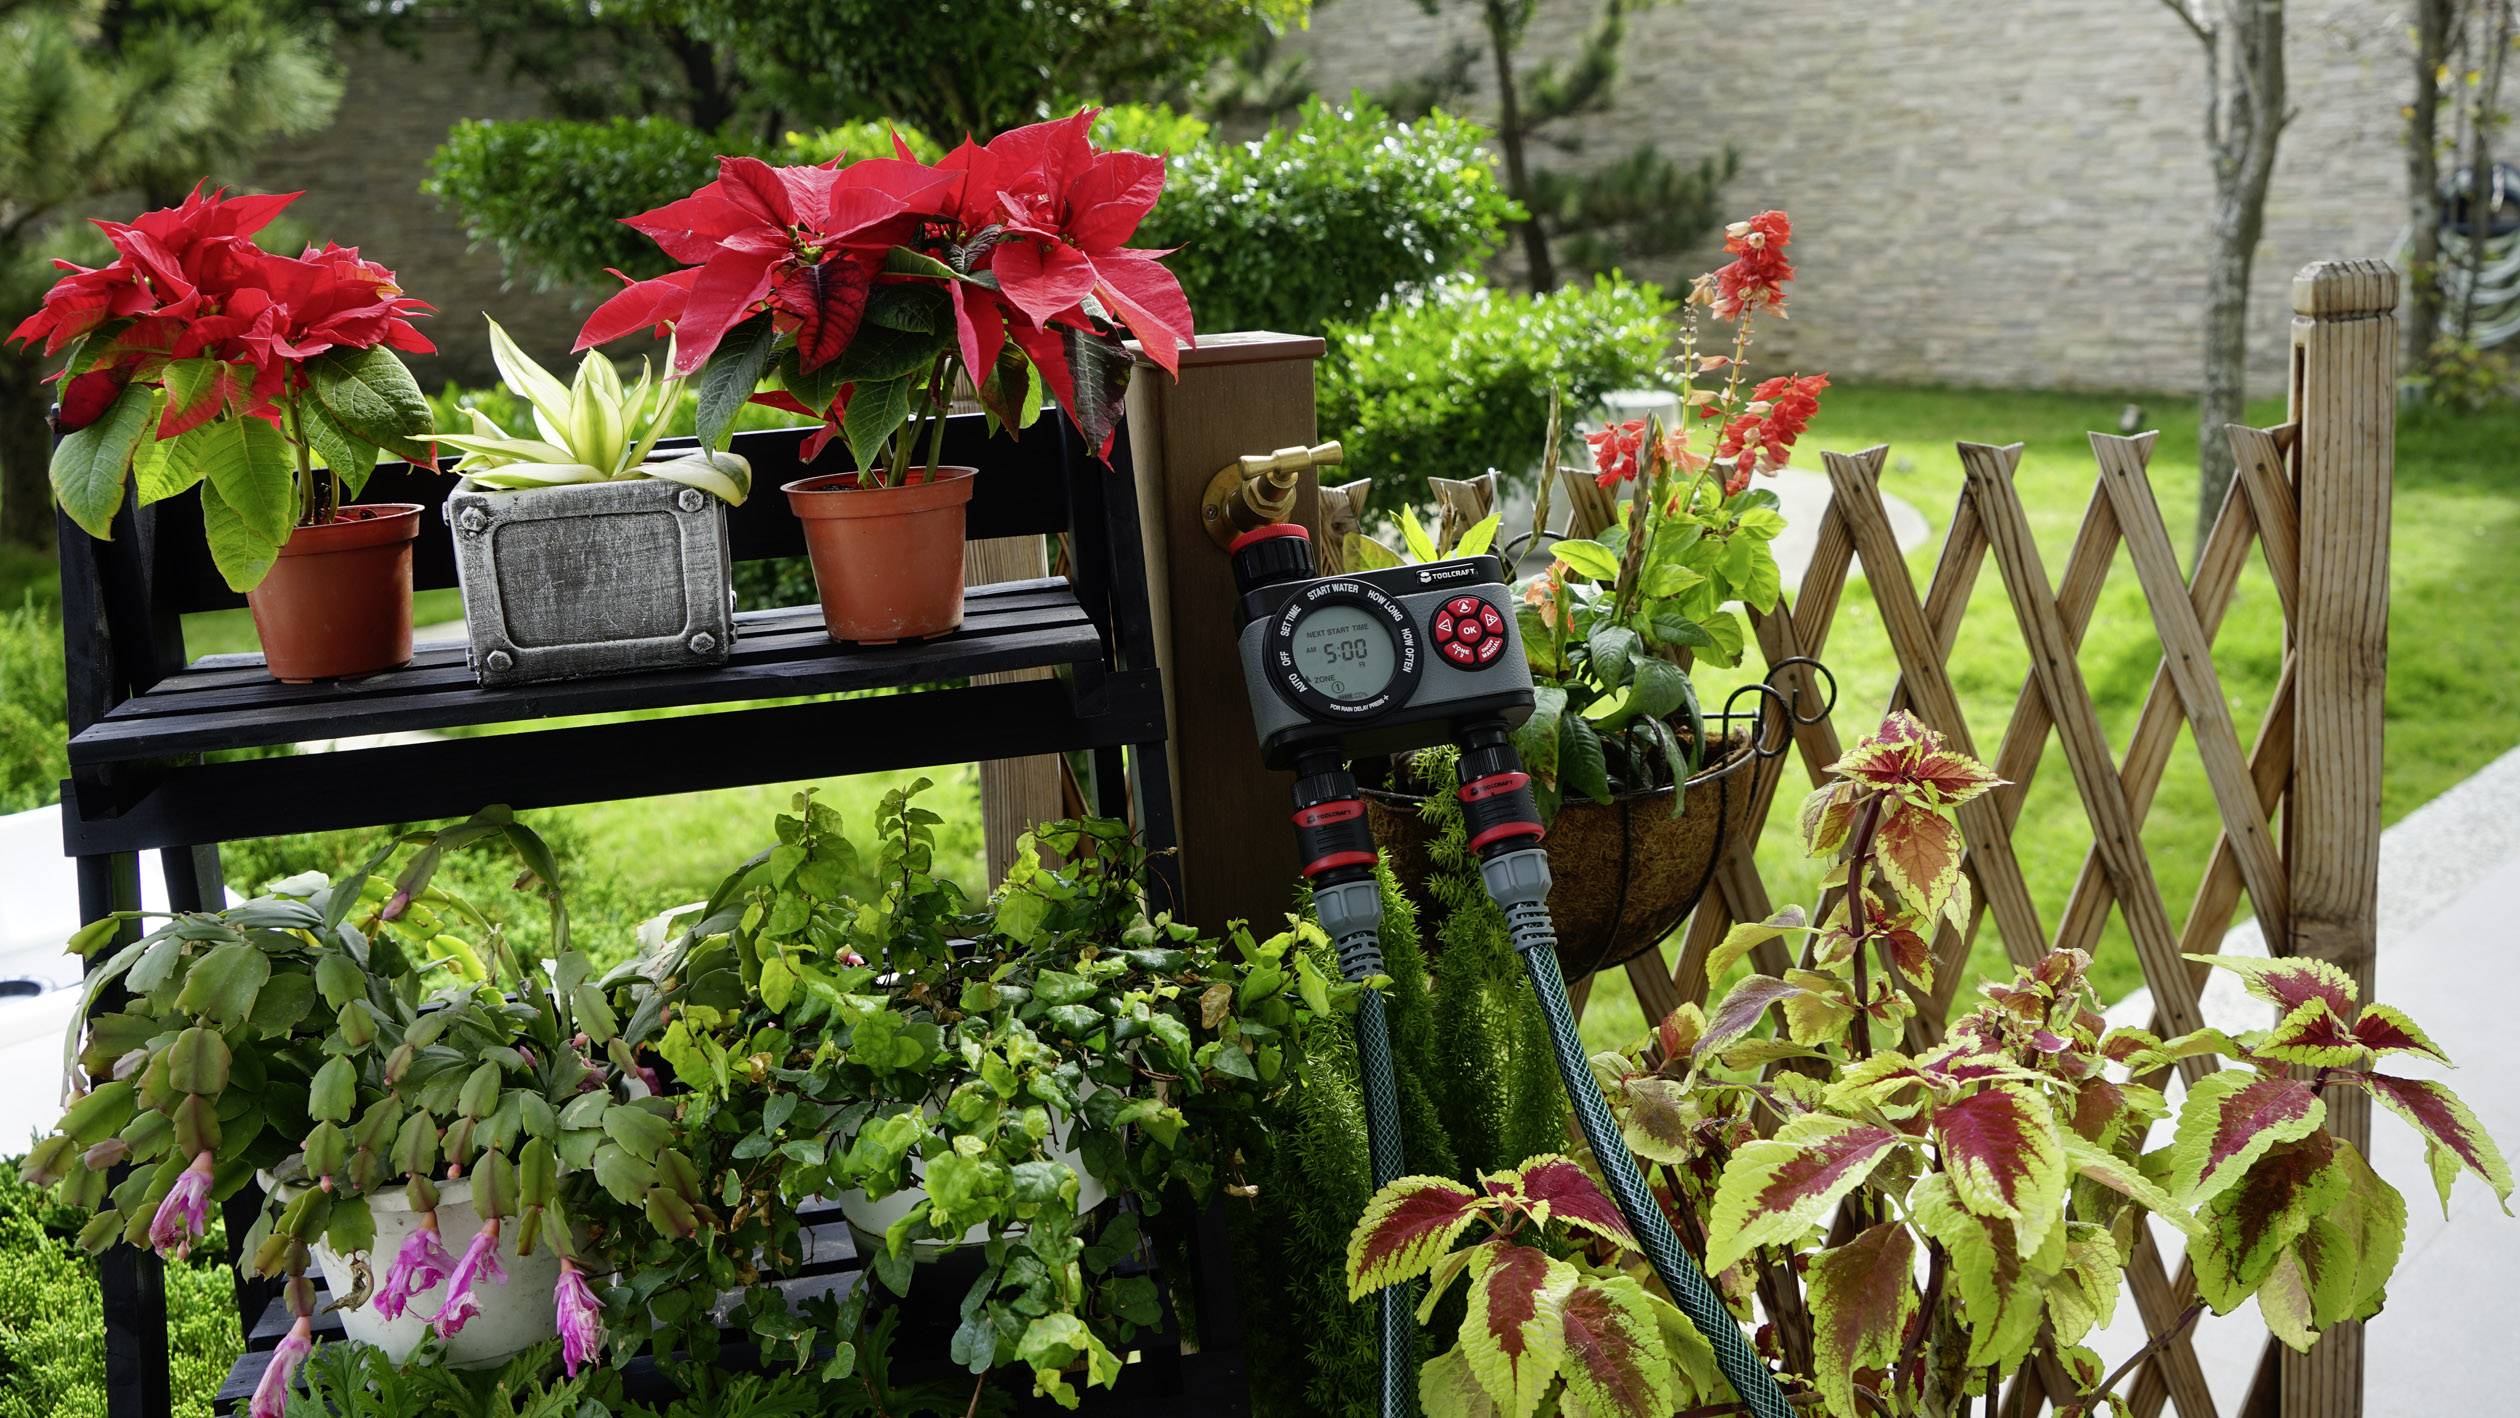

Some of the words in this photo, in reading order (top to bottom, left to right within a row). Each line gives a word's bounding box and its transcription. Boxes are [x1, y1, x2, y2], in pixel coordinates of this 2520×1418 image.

[1433, 569, 1474, 580] TOOLCRAFT
[1307, 584, 1330, 600] START
[1332, 583, 1358, 593] WATER
[1368, 590, 1385, 605] HOW
[1384, 601, 1403, 622] LONG
[1280, 620, 1292, 636] SET
[1286, 604, 1302, 622] TIME
[1327, 626, 1349, 636] START
[1401, 628, 1414, 646] HOW
[1324, 639, 1367, 664] 5:00
[1452, 644, 1470, 654] ZONE
[1482, 640, 1500, 658] MANUAL
[1280, 651, 1291, 666] OFF
[1403, 647, 1414, 673] OFTEN
[1289, 673, 1308, 693] AUTO
[1315, 674, 1336, 684] ZONE
[1317, 810, 1351, 819] TOOLCRAFT
